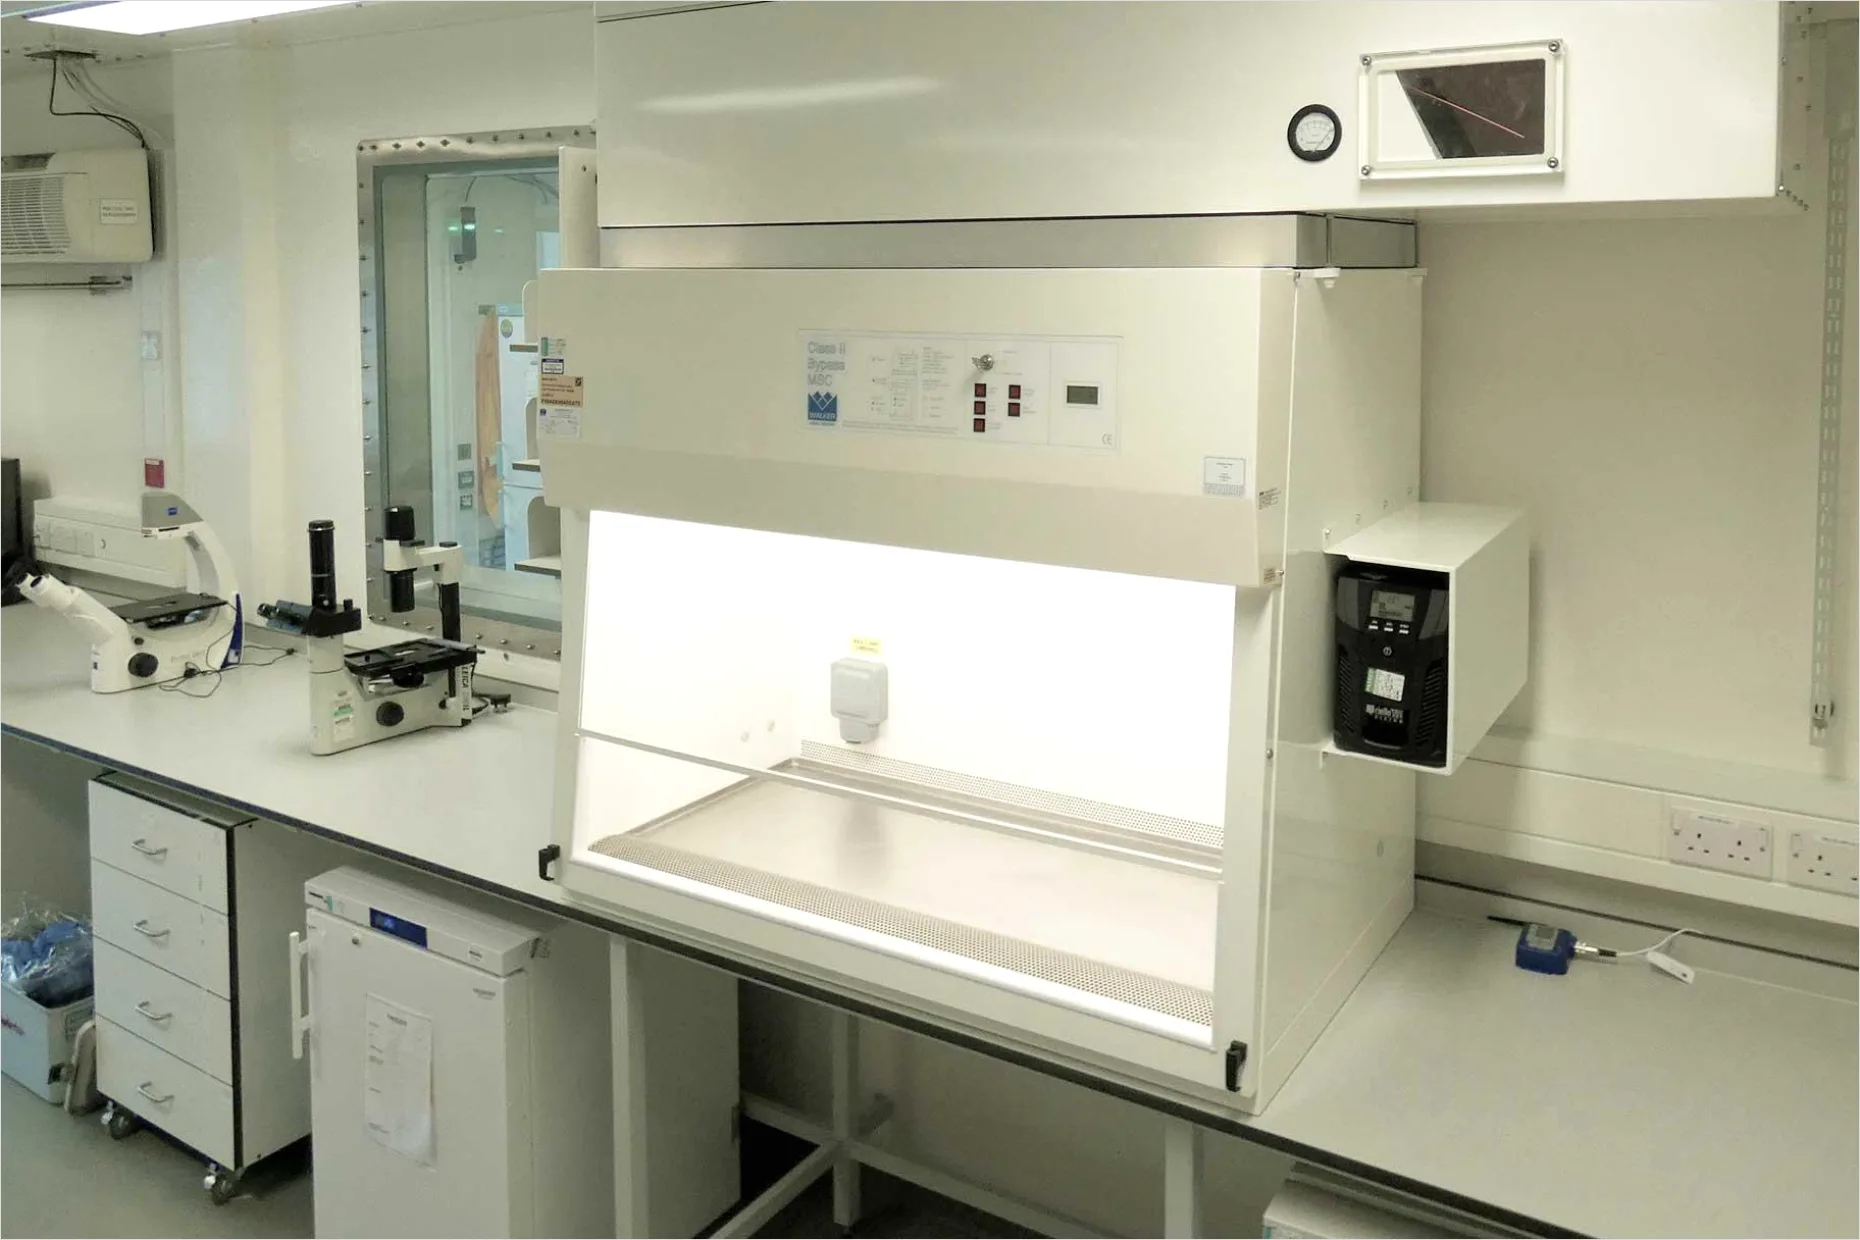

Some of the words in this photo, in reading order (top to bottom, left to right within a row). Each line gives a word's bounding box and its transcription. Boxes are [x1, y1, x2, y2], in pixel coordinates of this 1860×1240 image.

[808, 341, 836, 354] Class
[808, 357, 845, 372] Bypass
[807, 373, 833, 387] MSC
